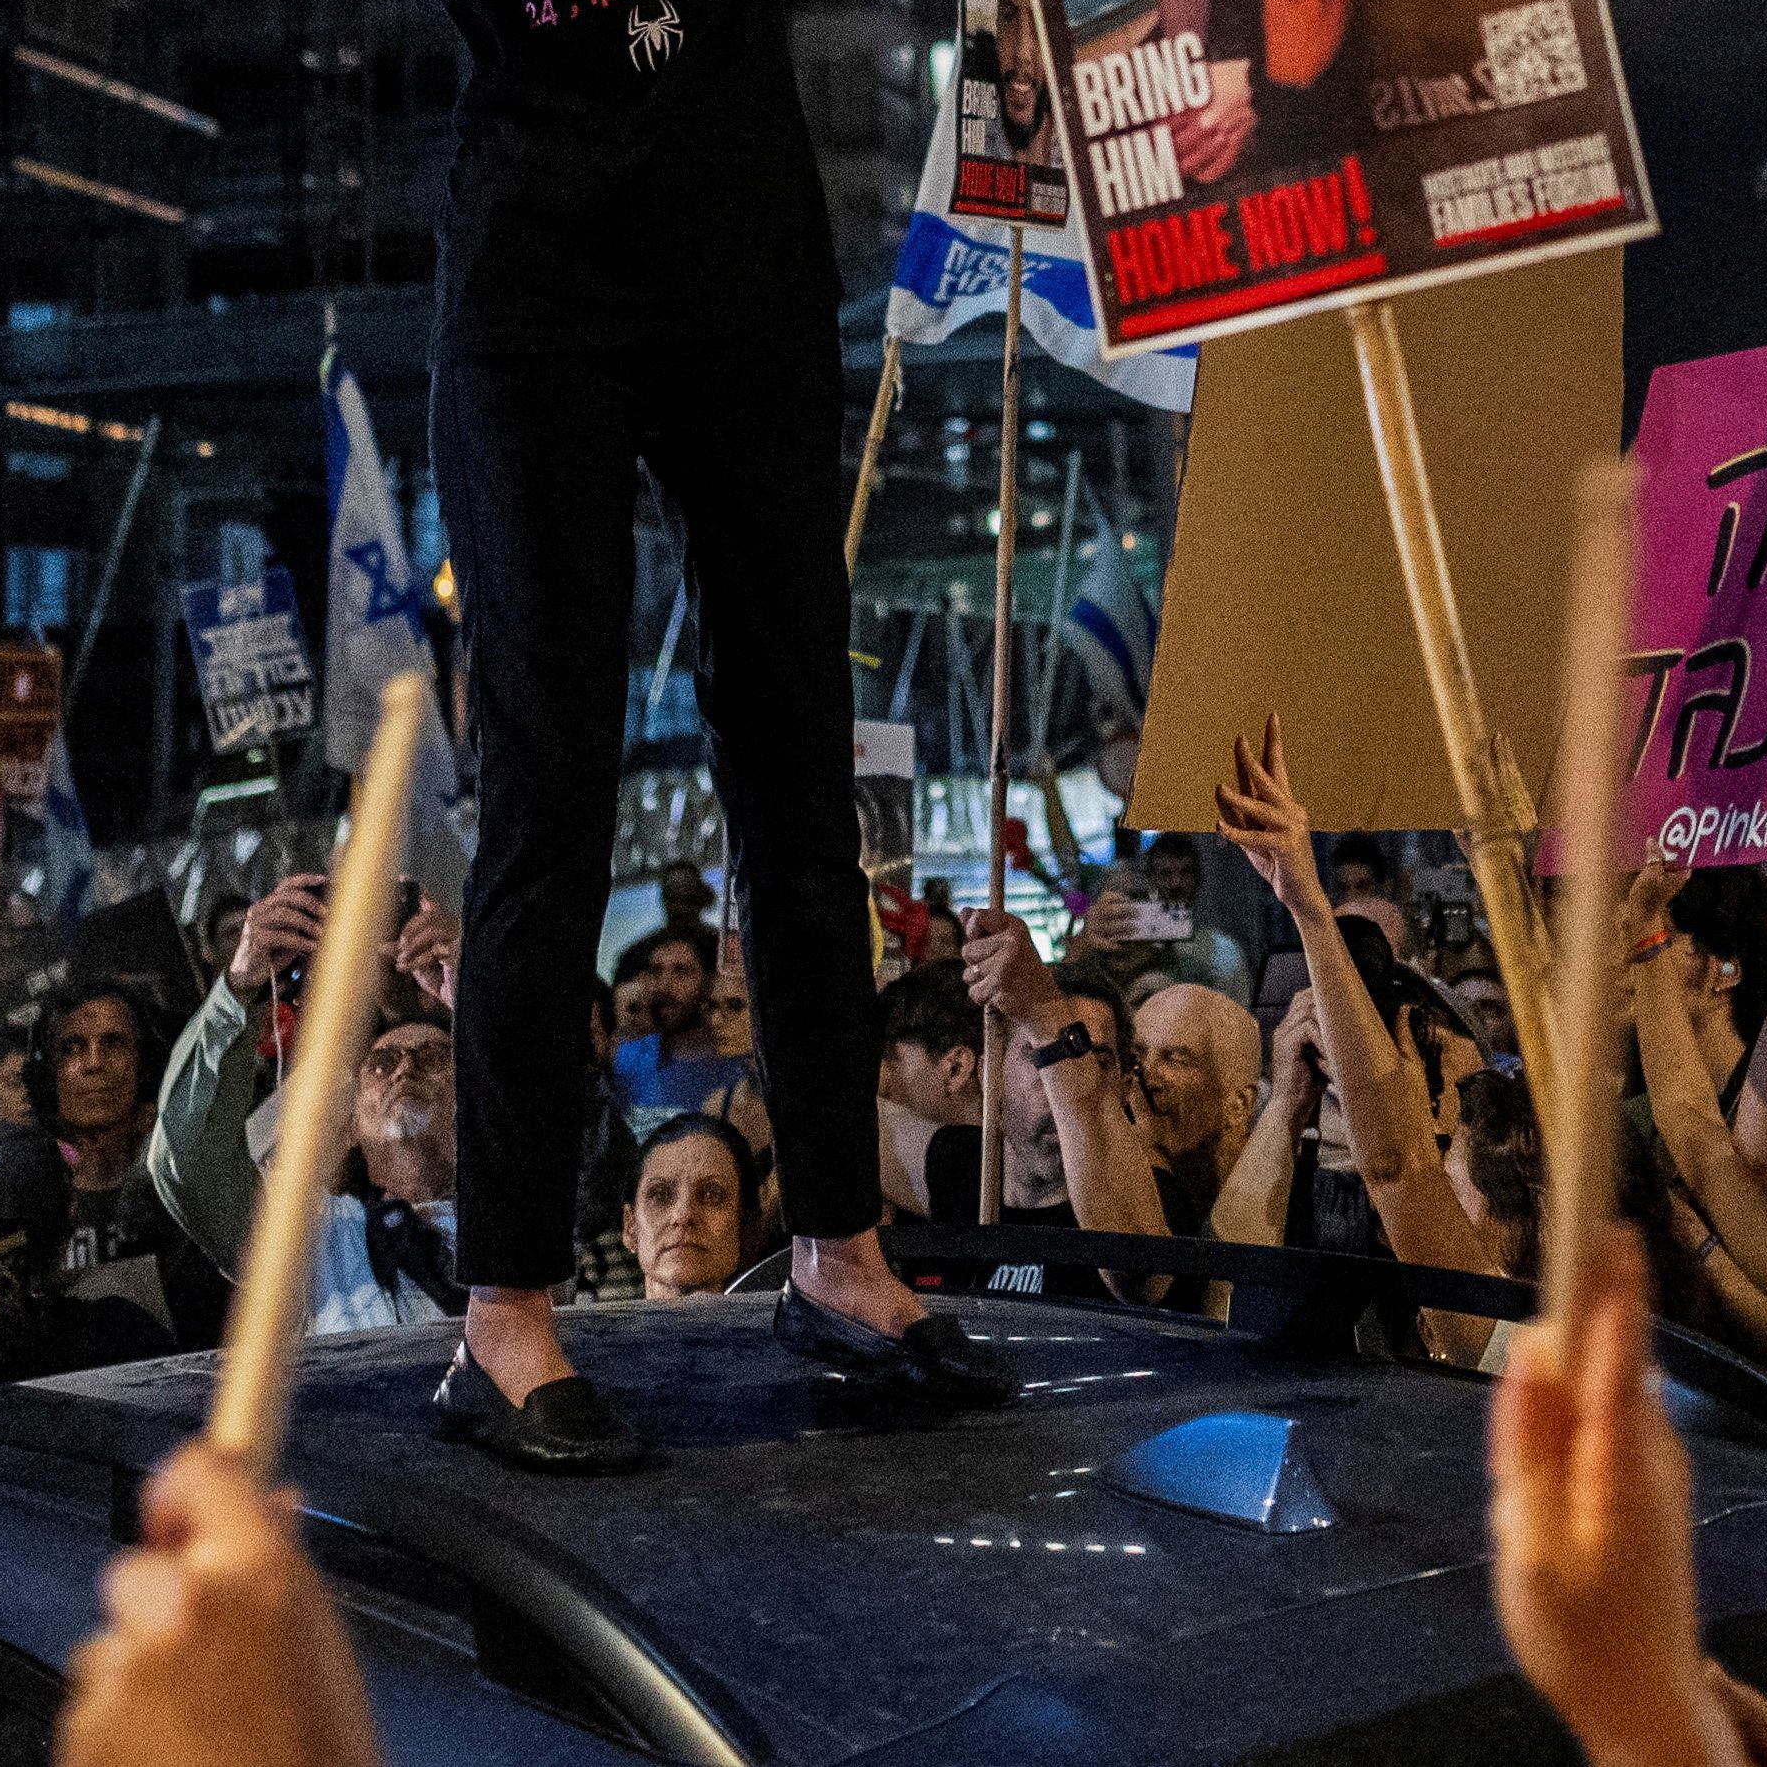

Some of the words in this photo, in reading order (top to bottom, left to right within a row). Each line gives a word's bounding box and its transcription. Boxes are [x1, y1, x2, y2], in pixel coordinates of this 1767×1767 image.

[1073, 30, 1212, 137] BRING
[1089, 130, 1182, 217] HIM
[1109, 201, 1239, 304] HOME
[1239, 155, 1375, 271] NOW!
